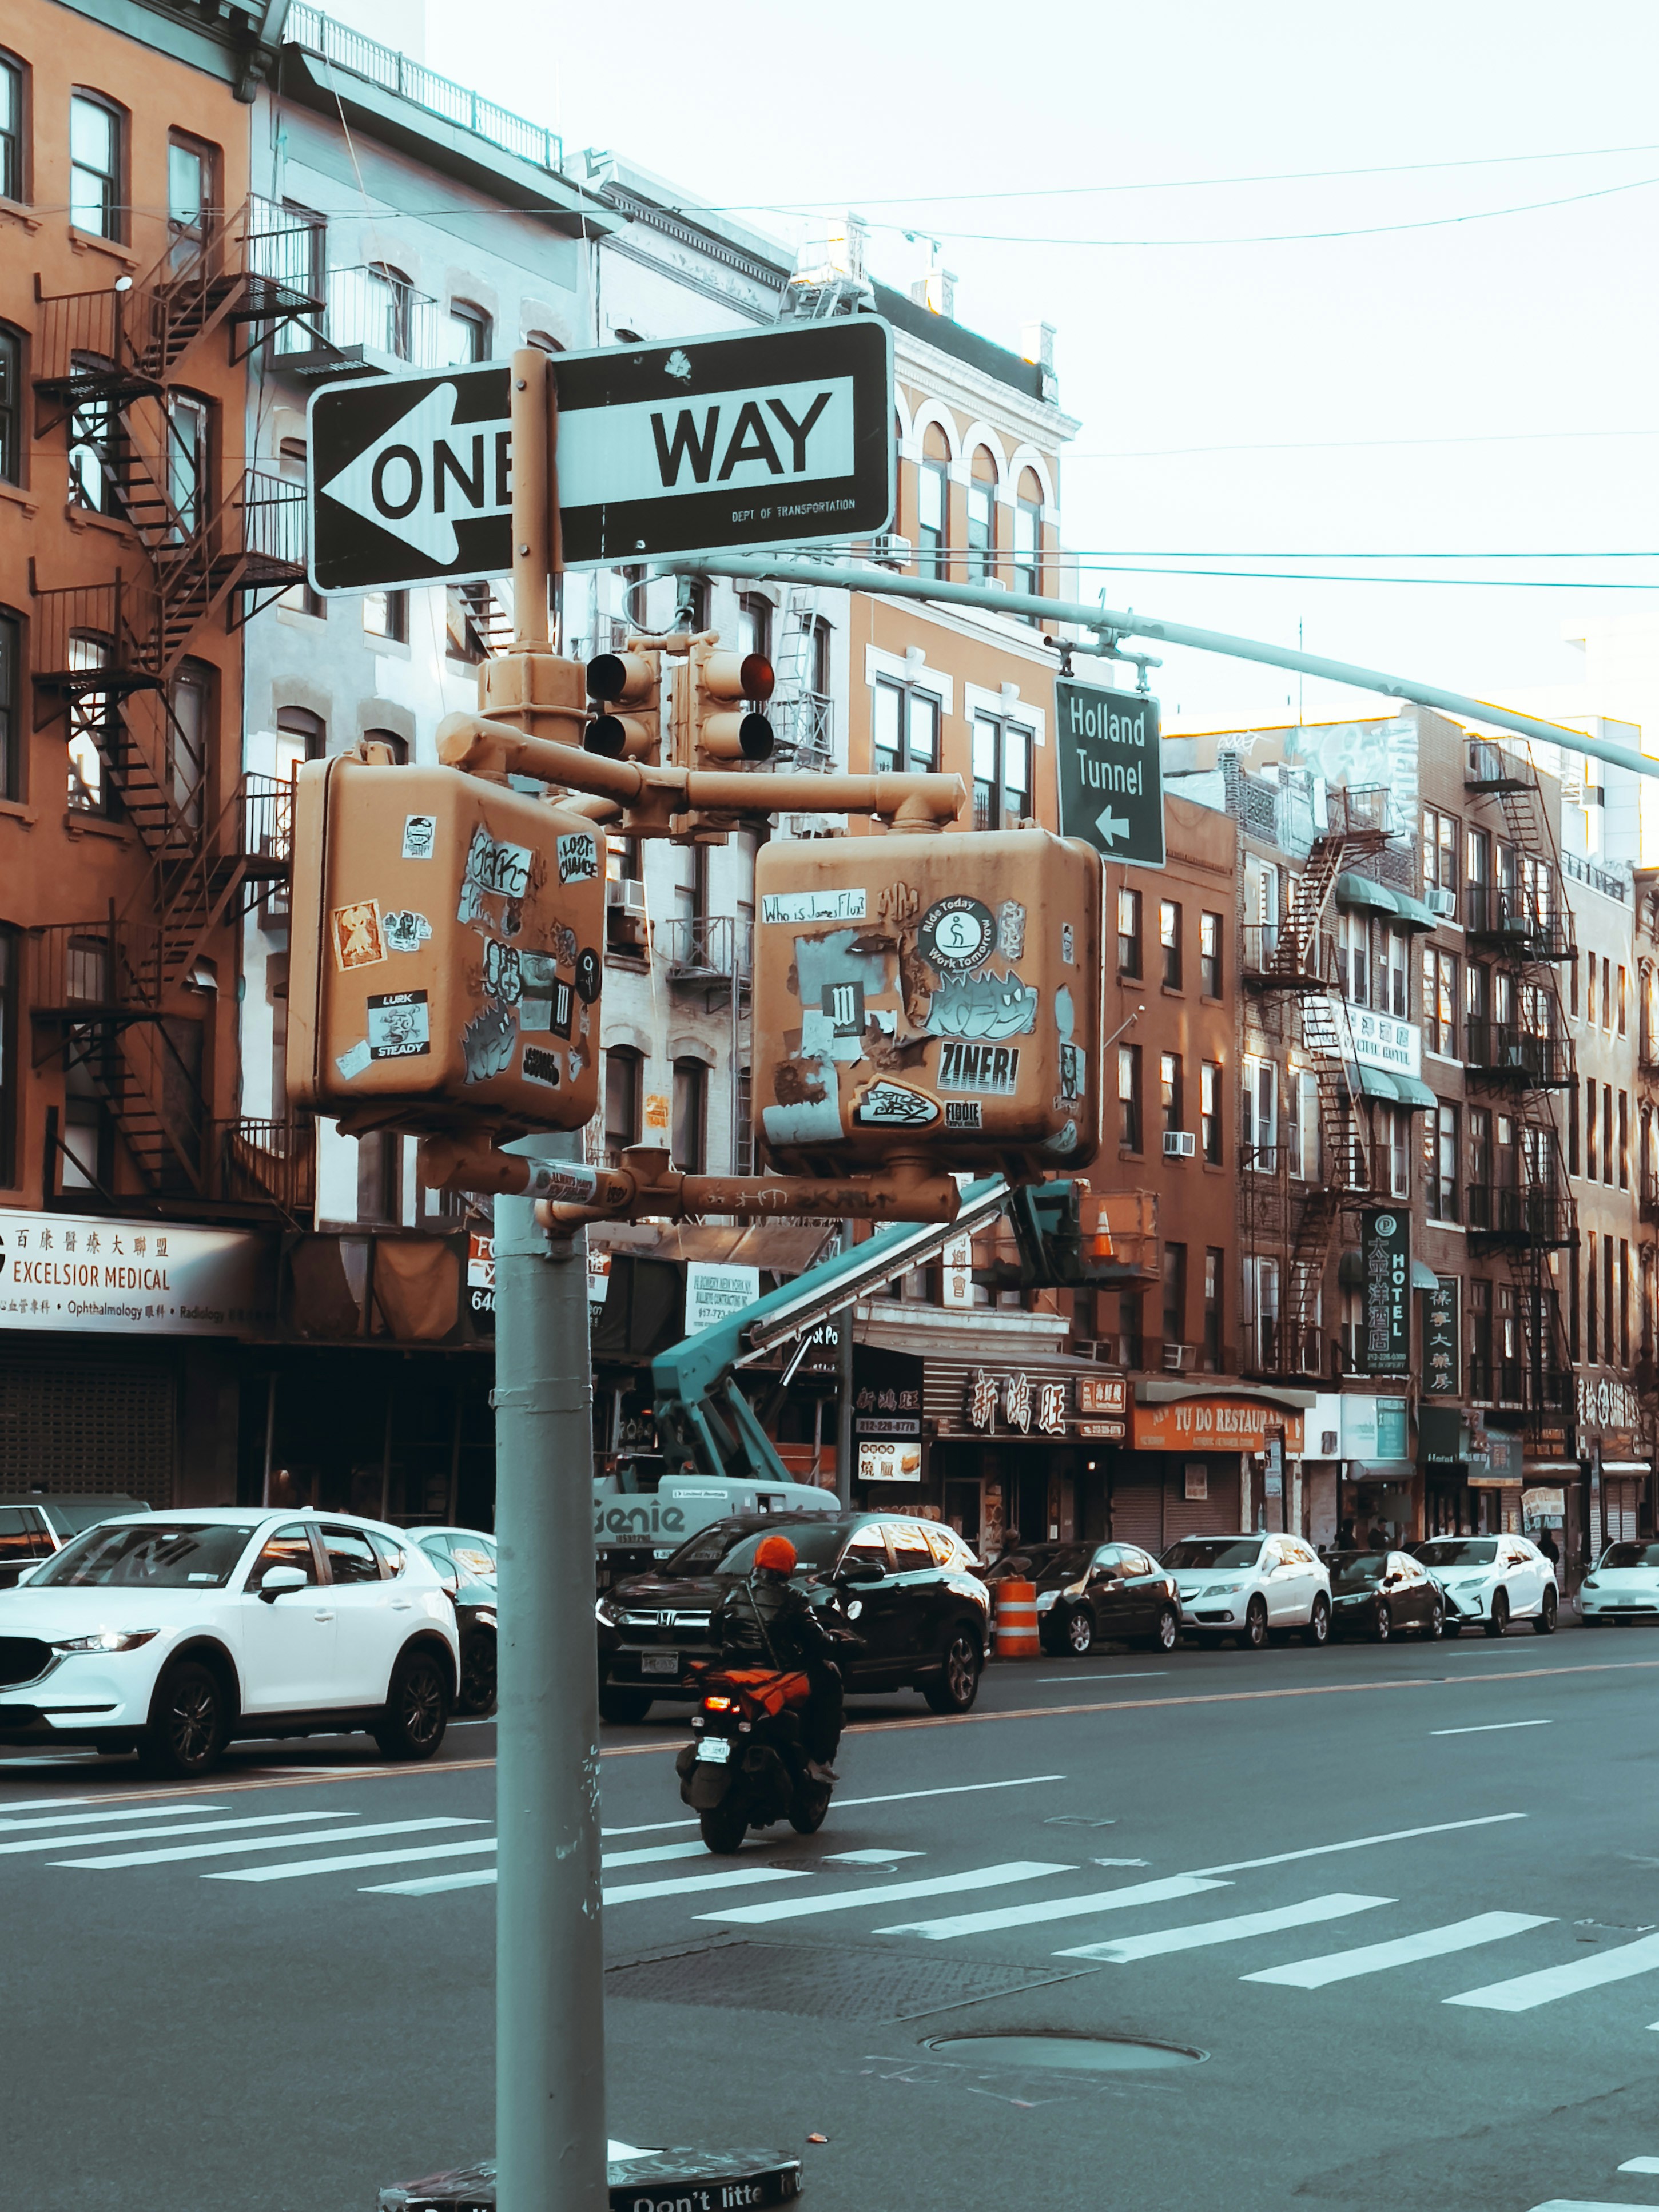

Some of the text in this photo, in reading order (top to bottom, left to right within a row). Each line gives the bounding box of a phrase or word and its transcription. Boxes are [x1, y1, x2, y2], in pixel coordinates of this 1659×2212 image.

[650, 392, 833, 487] WAY
[760, 507, 772, 519] OF
[777, 499, 856, 518] TRANSPORTATION
[1070, 697, 1145, 747] Holland
[1076, 748, 1143, 796] Tunnel
[763, 897, 790, 922] Who
[793, 903, 805, 921] is
[922, 909, 942, 933] Ride
[940, 897, 976, 911] Today
[929, 947, 956, 969] Work
[958, 919, 992, 968] Tomorrow
[383, 993, 413, 1005] LURK
[378, 1043, 424, 1057] STEADY
[15, 1228, 168, 1258] 百康醫療大聯盟
[14, 1260, 170, 1291] EXCELSIOR MEDICAL
[1367, 1236, 1390, 1352] 太平洋酒店
[1392, 1254, 1405, 1336] HOTEL
[68, 1300, 142, 1321] Ophthalmology
[180, 1305, 225, 1323] Radiology
[972, 1368, 1066, 1435] 新鴻旺
[1195, 1406, 1212, 1431] DO
[633, 2185, 765, 2212] Don't litte
